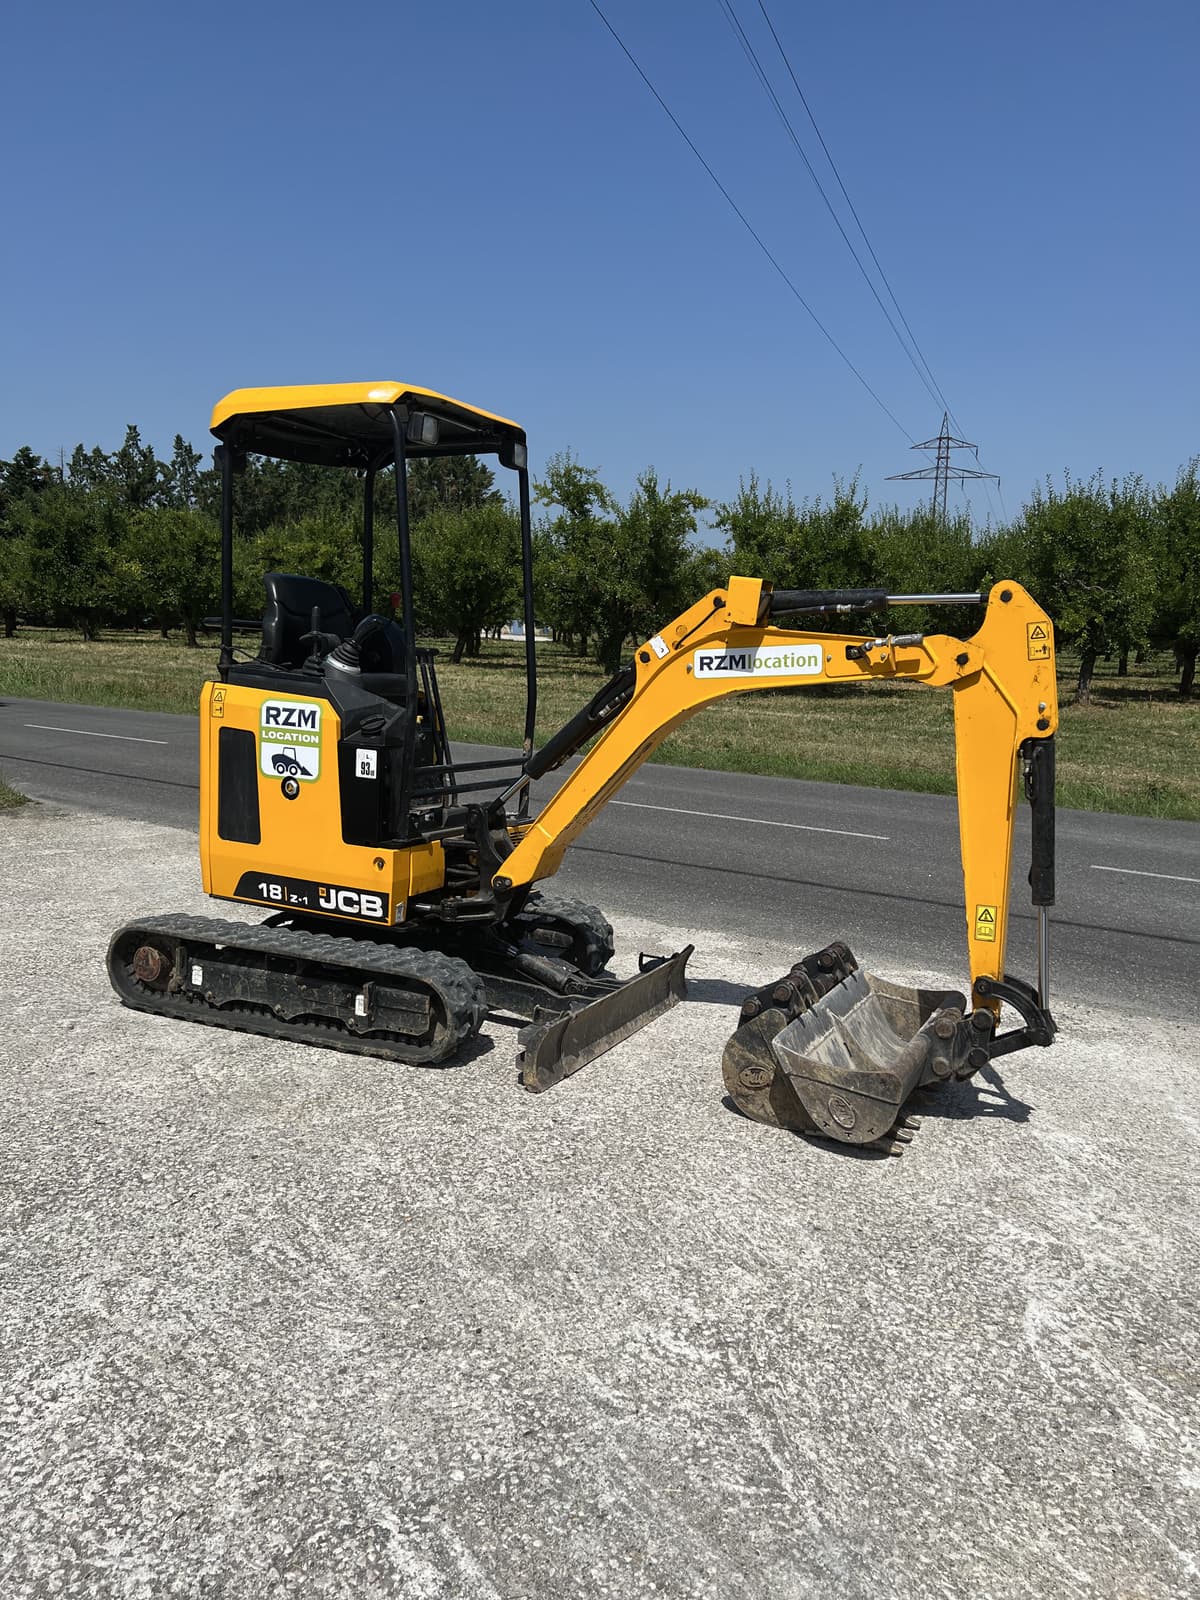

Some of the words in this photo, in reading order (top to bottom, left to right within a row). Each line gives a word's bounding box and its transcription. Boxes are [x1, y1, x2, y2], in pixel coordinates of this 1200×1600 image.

[265, 706, 318, 729] RZM
[262, 730, 319, 744] LOCATION
[258, 883, 282, 900] 18
[319, 888, 384, 918] JCB
